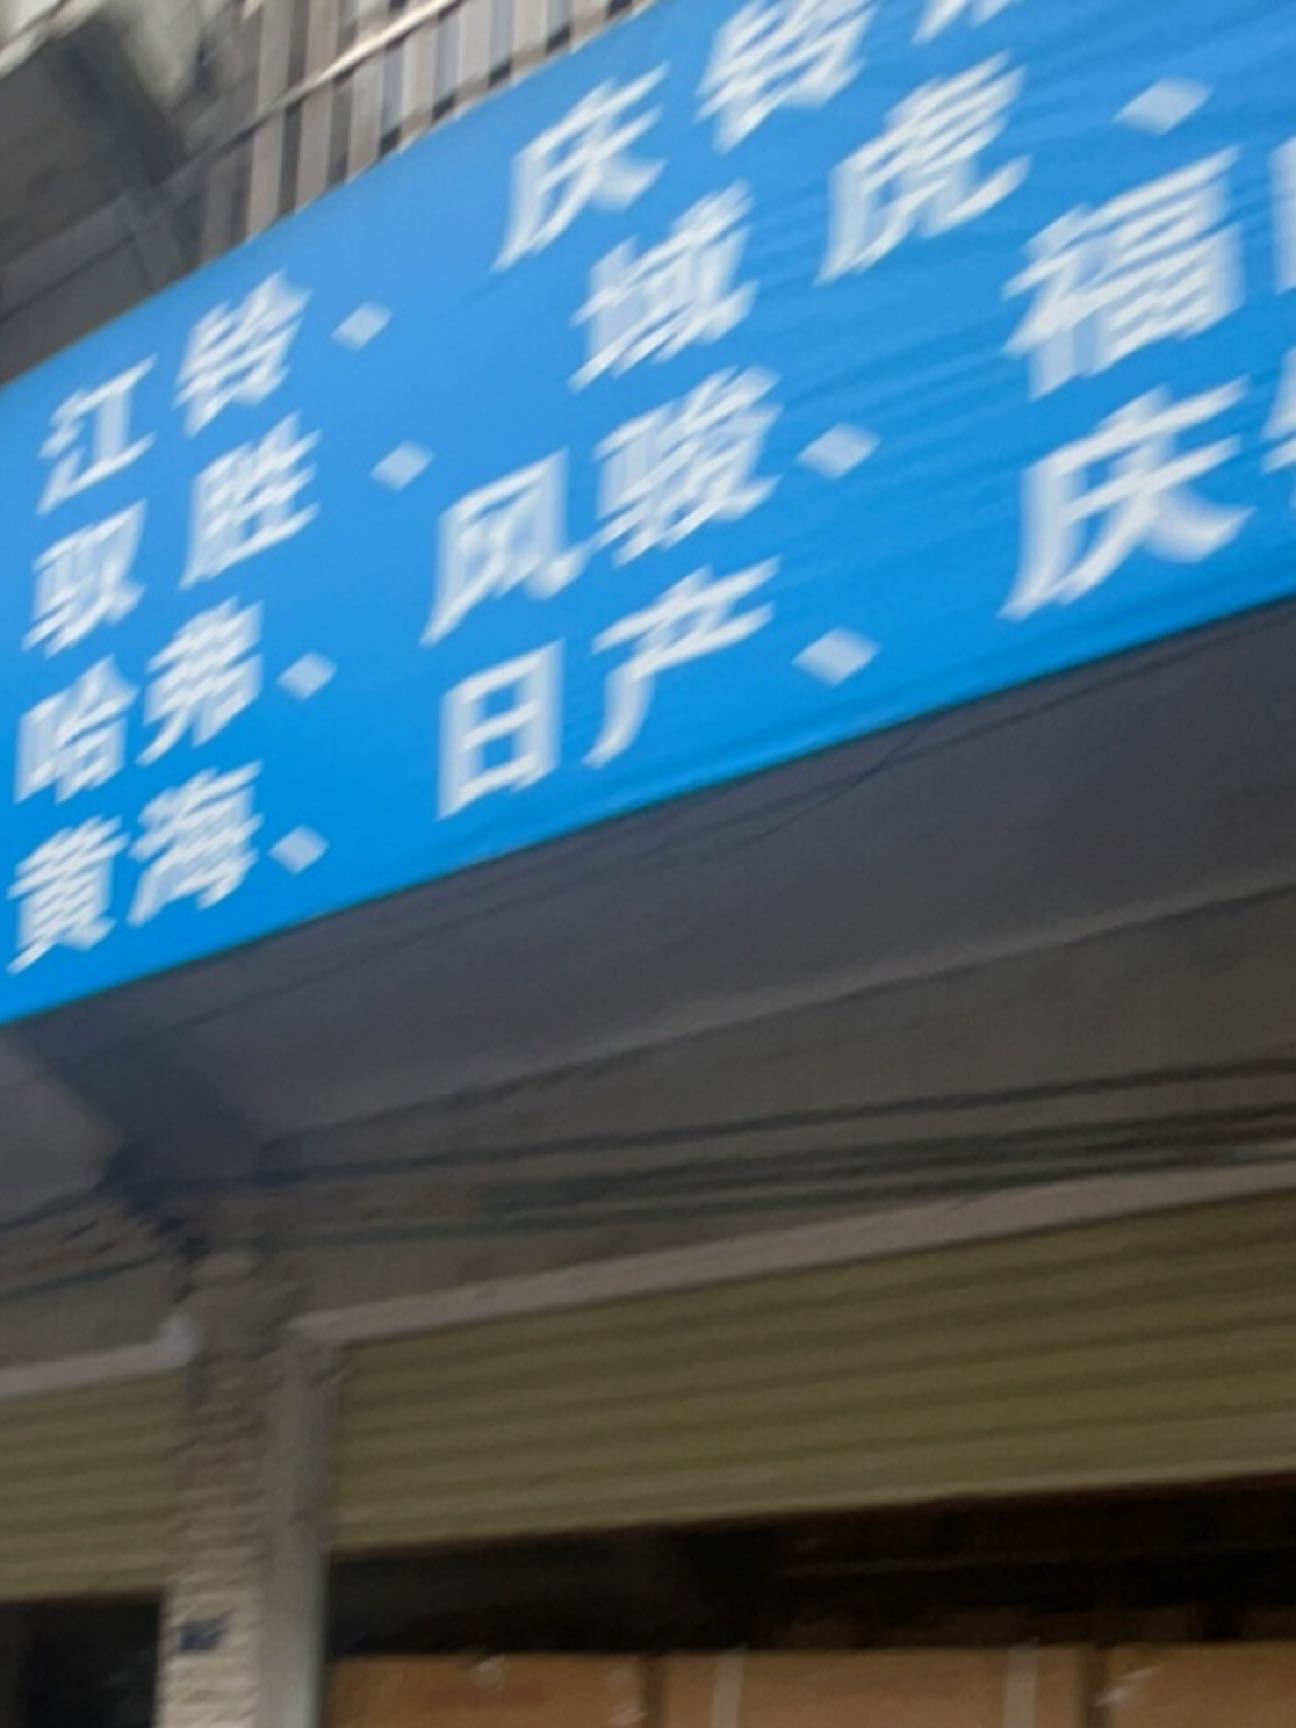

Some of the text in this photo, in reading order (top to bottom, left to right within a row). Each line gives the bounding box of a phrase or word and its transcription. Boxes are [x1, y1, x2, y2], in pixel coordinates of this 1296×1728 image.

[14, 135, 1296, 805] 哈弗 风骏 福
[22, 48, 1032, 658] 驭胜 域虎
[38, 0, 1016, 515] 江铃 庆铃
[7, 345, 1296, 975] 黄海 日产 庆
